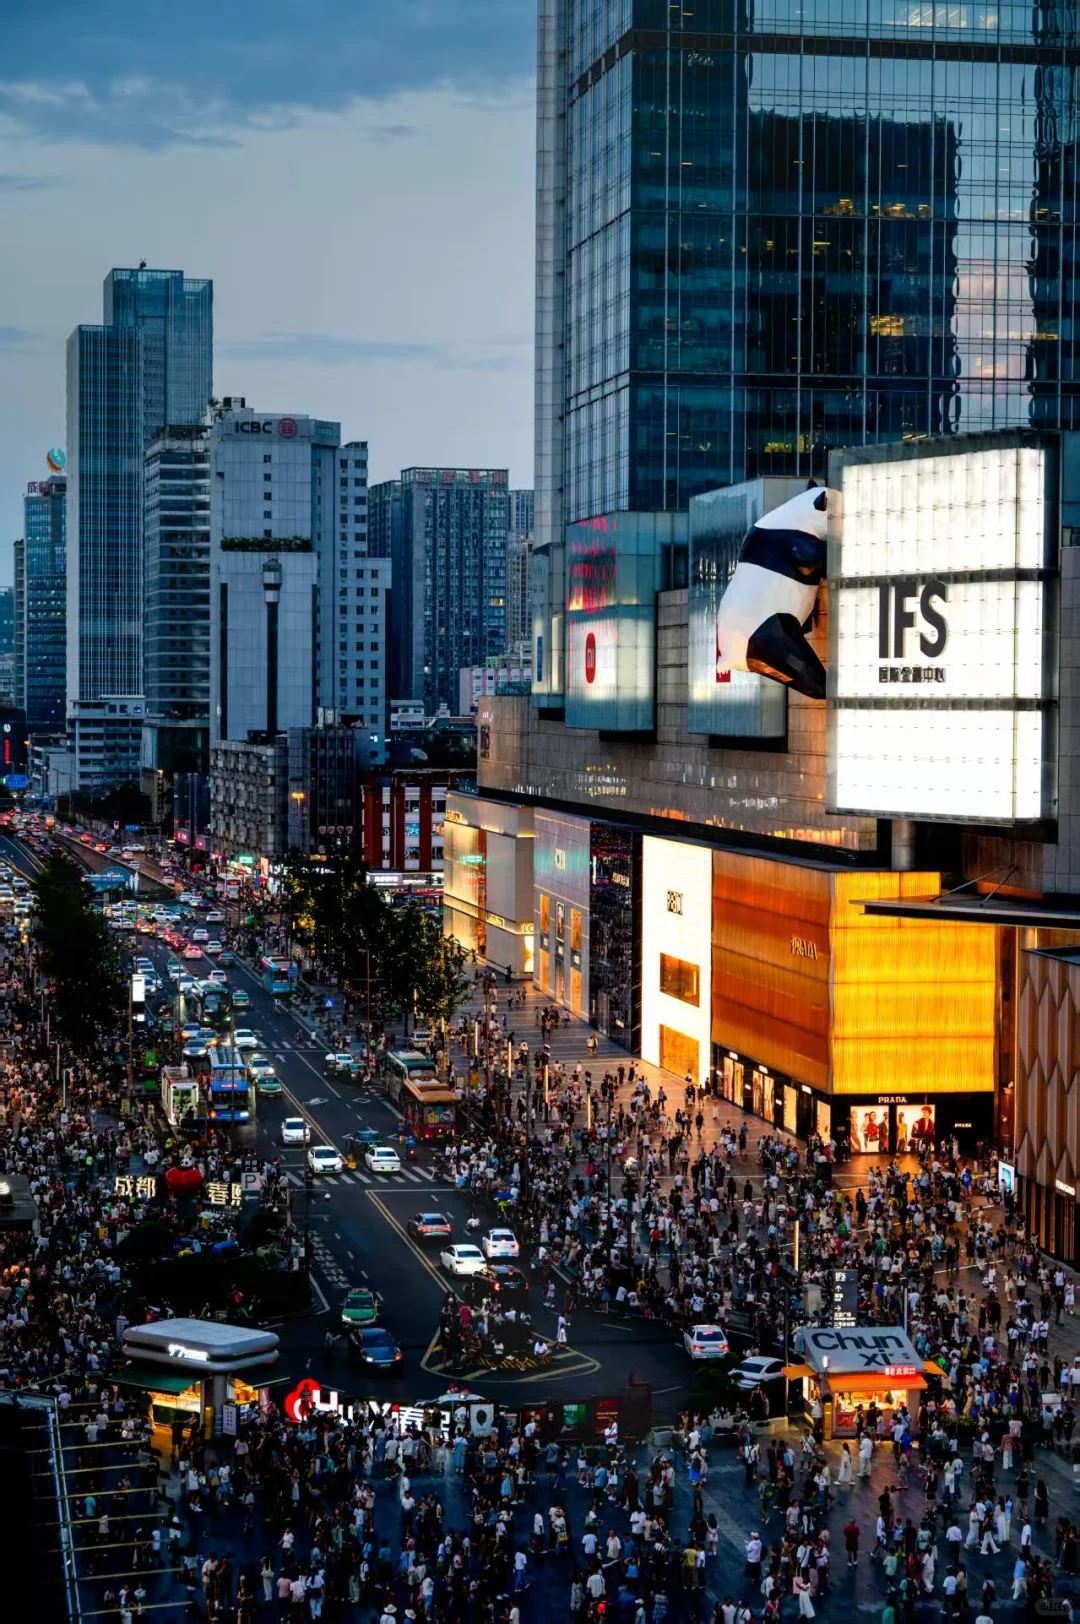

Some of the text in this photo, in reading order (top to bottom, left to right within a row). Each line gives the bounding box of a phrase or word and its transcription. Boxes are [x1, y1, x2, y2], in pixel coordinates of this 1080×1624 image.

[235, 421, 272, 433] ICBC
[879, 580, 947, 658] IFS
[791, 937, 817, 960] PRADA
[878, 1096, 907, 1104] PRADA
[114, 1175, 157, 1199] 成都
[245, 1175, 257, 1189] P
[835, 1272, 847, 1282] IFS
[811, 1331, 904, 1351] Chun
[859, 1348, 893, 1367] xi
